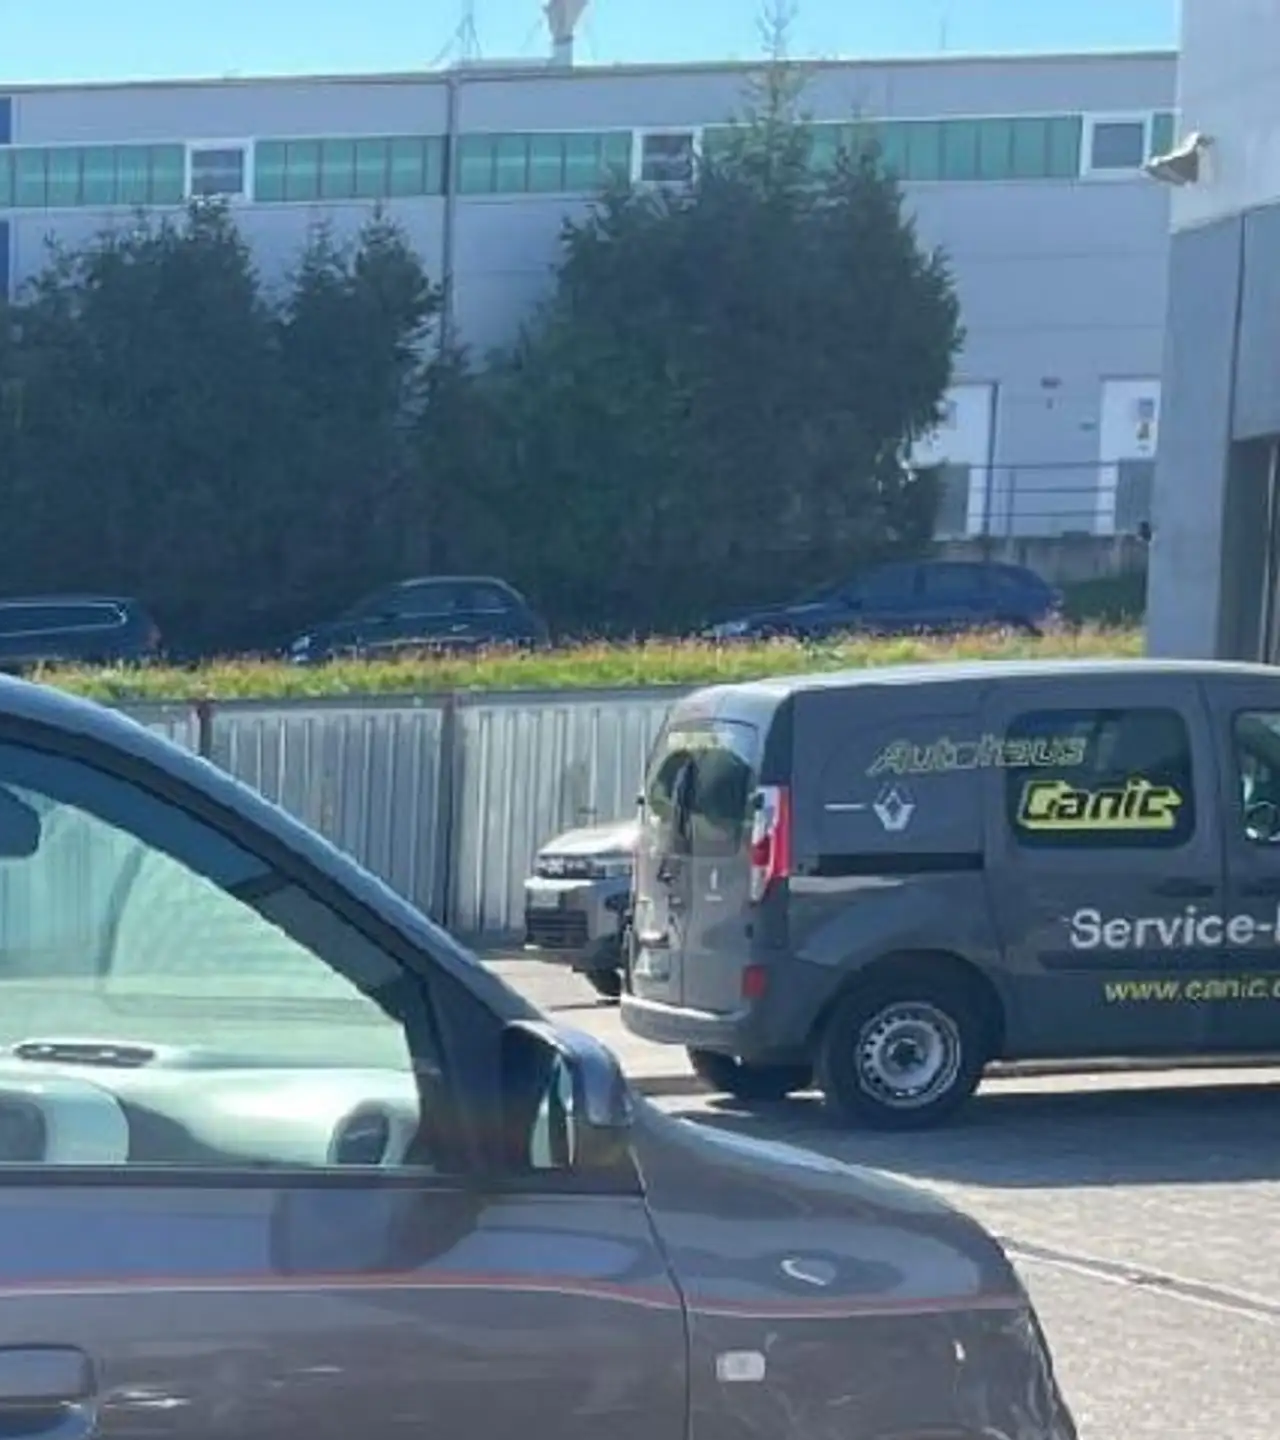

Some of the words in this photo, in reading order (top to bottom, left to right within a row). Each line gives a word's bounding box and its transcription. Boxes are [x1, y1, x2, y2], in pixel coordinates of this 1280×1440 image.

[866, 734, 1086, 776] Autohaus
[1018, 775, 1183, 829] Canic
[1070, 905, 1280, 948] Service-
